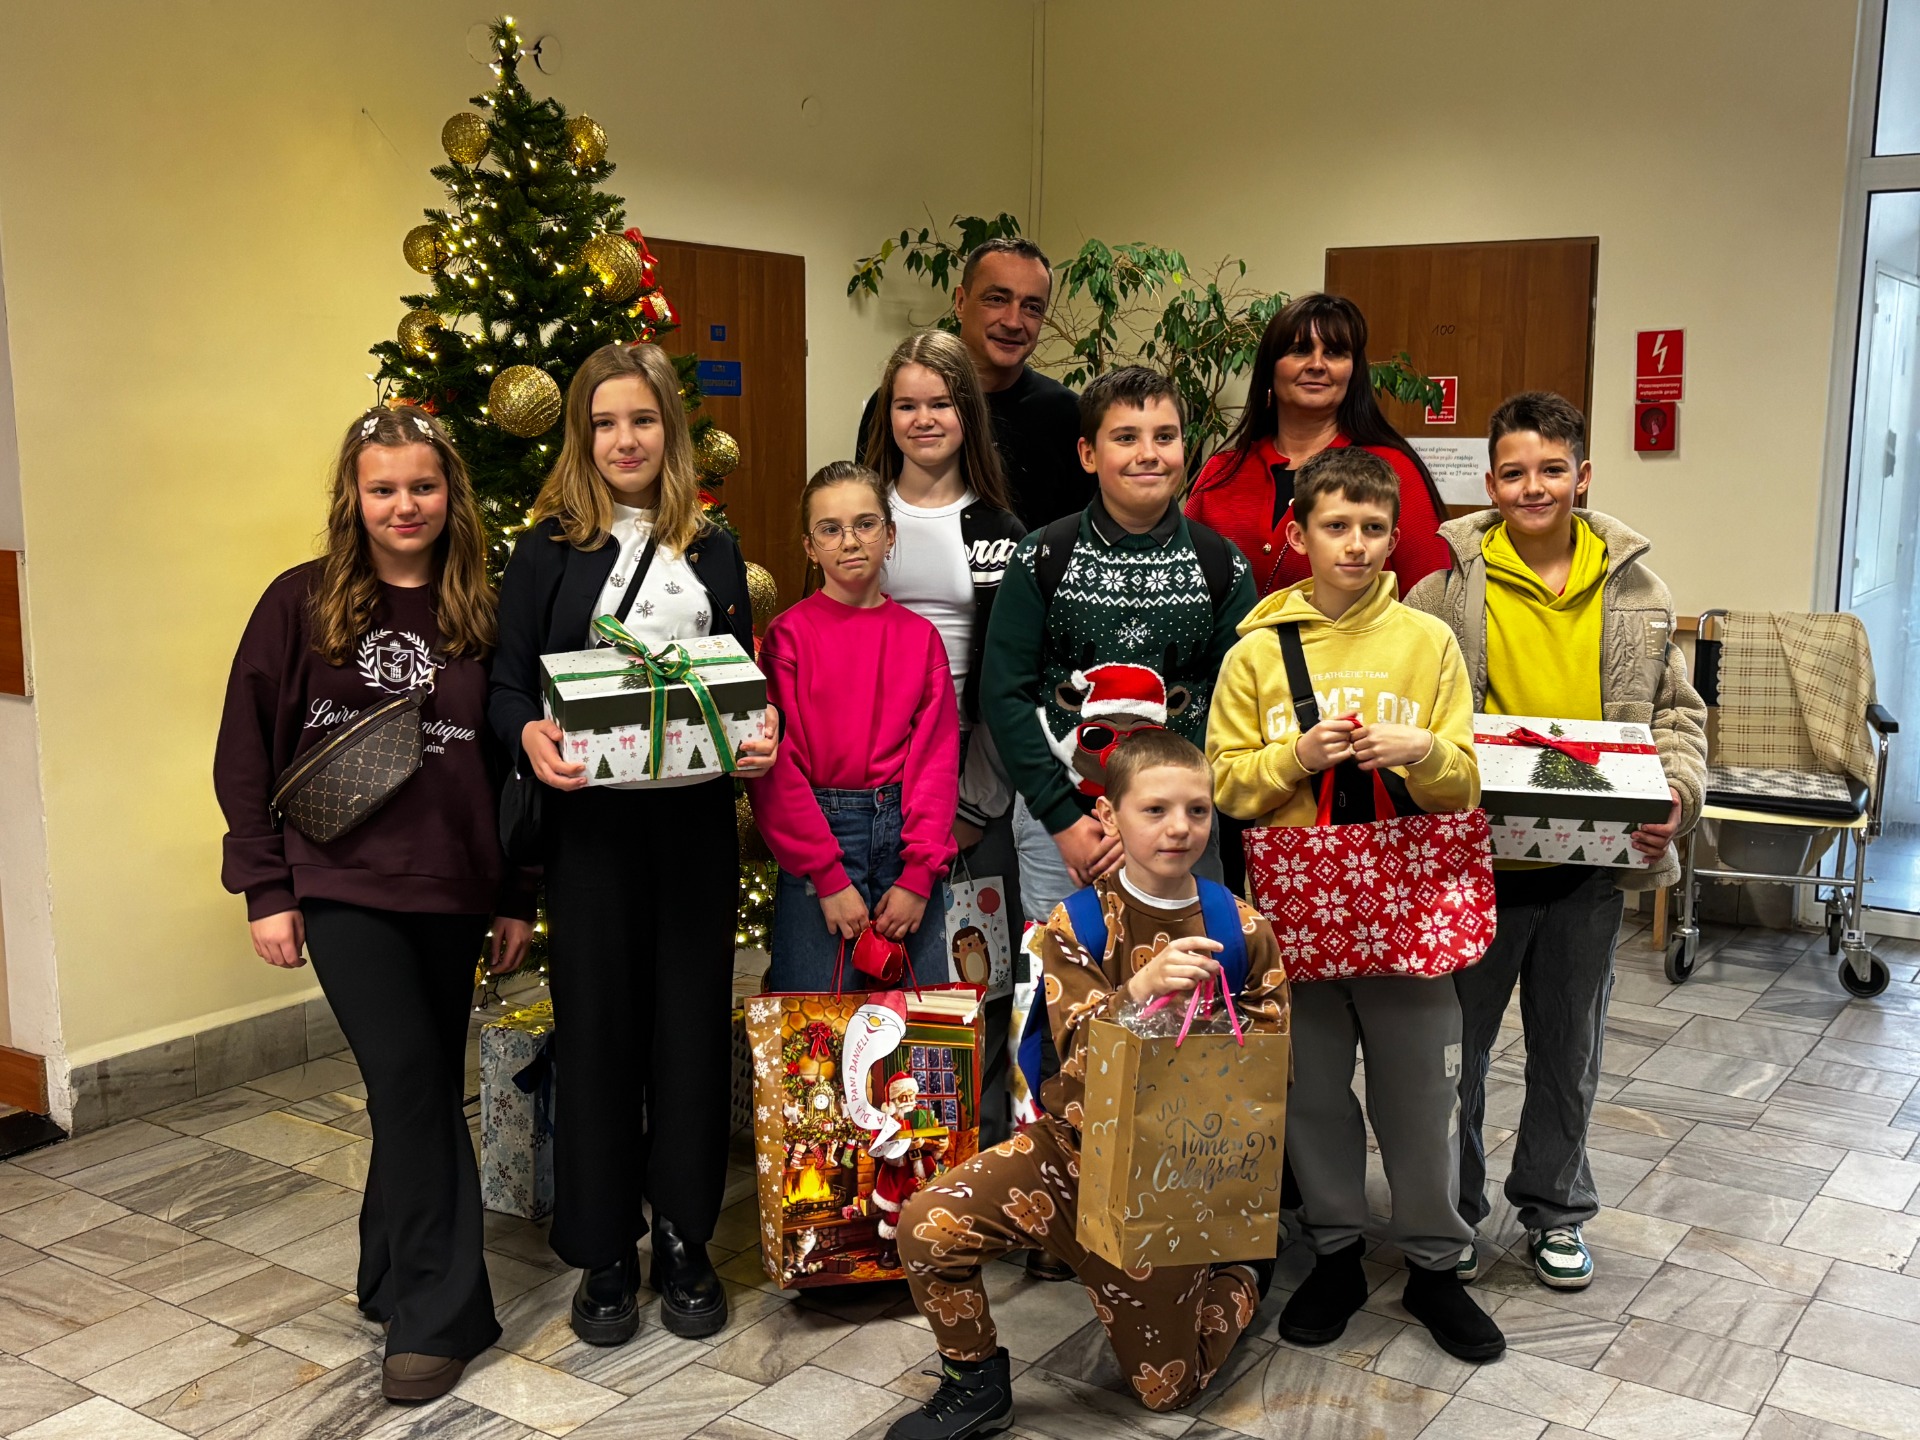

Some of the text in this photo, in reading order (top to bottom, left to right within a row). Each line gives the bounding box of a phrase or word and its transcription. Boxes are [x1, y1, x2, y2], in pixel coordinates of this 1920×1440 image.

[1431, 324, 1456, 336] 100
[1325, 670, 1363, 679] ATHLETIC
[1364, 670, 1389, 679] TEAM
[303, 698, 360, 729] Loire
[1377, 691, 1421, 728] ON
[849, 1034, 870, 1073] DANIELI
[850, 1077, 860, 1102] PANI
[1165, 1113, 1229, 1158] Time
[1153, 1132, 1265, 1194] Celebrate
